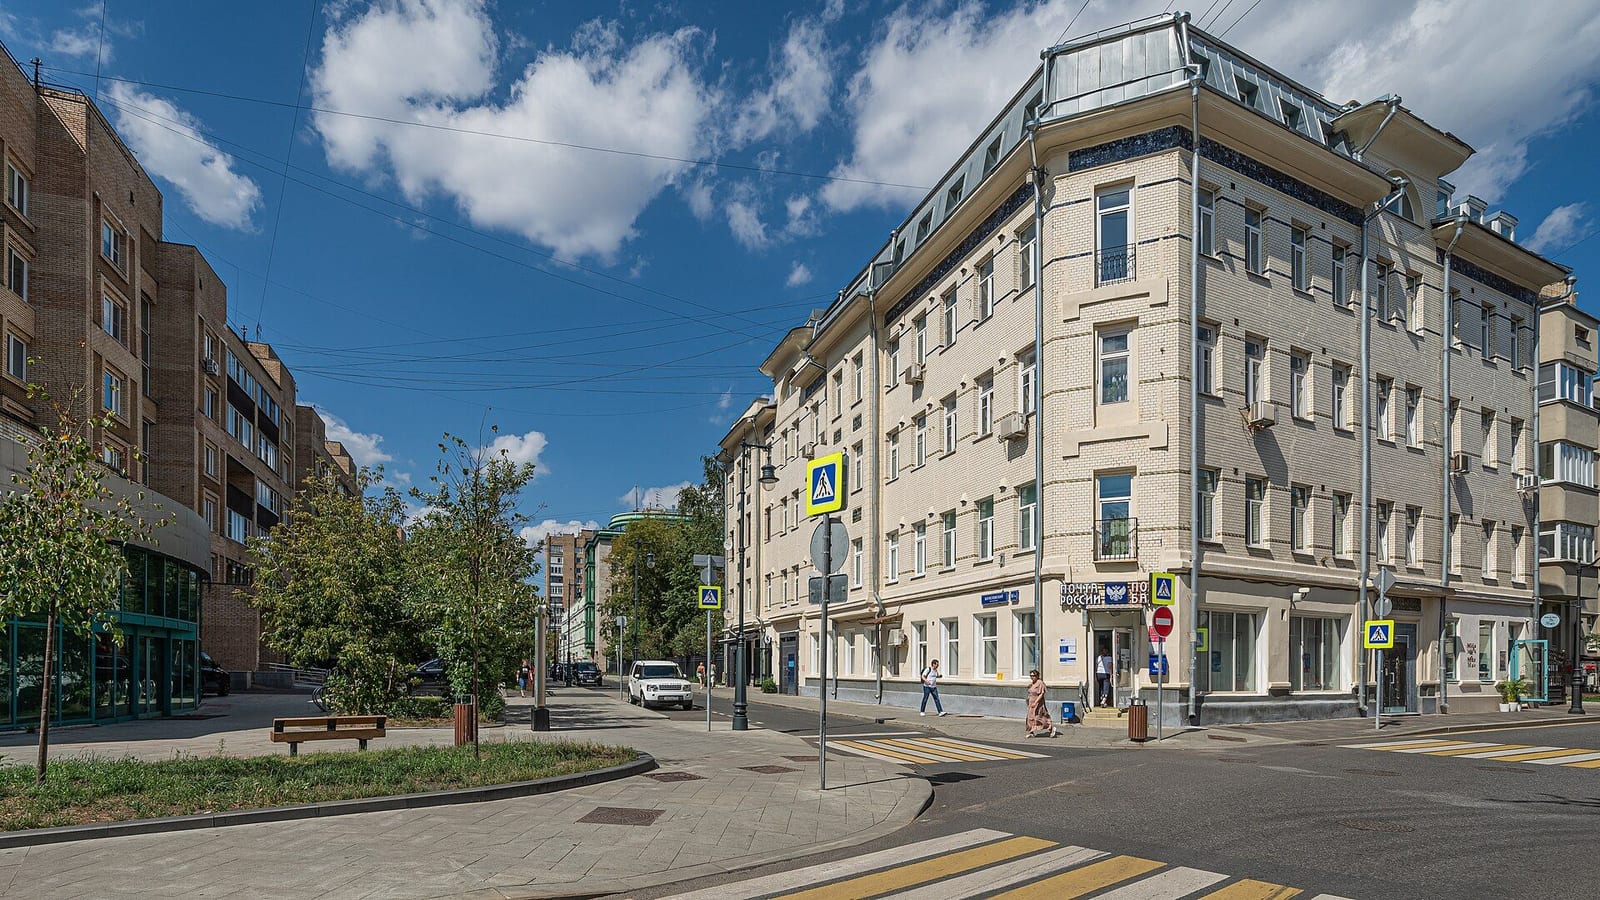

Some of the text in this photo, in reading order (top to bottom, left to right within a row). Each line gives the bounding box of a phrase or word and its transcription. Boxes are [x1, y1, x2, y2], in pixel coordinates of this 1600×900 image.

[1060, 583, 1098, 594] ПОЧТА
[1131, 581, 1149, 592] ПО
[1060, 594, 1101, 605] РОССИИ
[1131, 593, 1149, 604] БА
